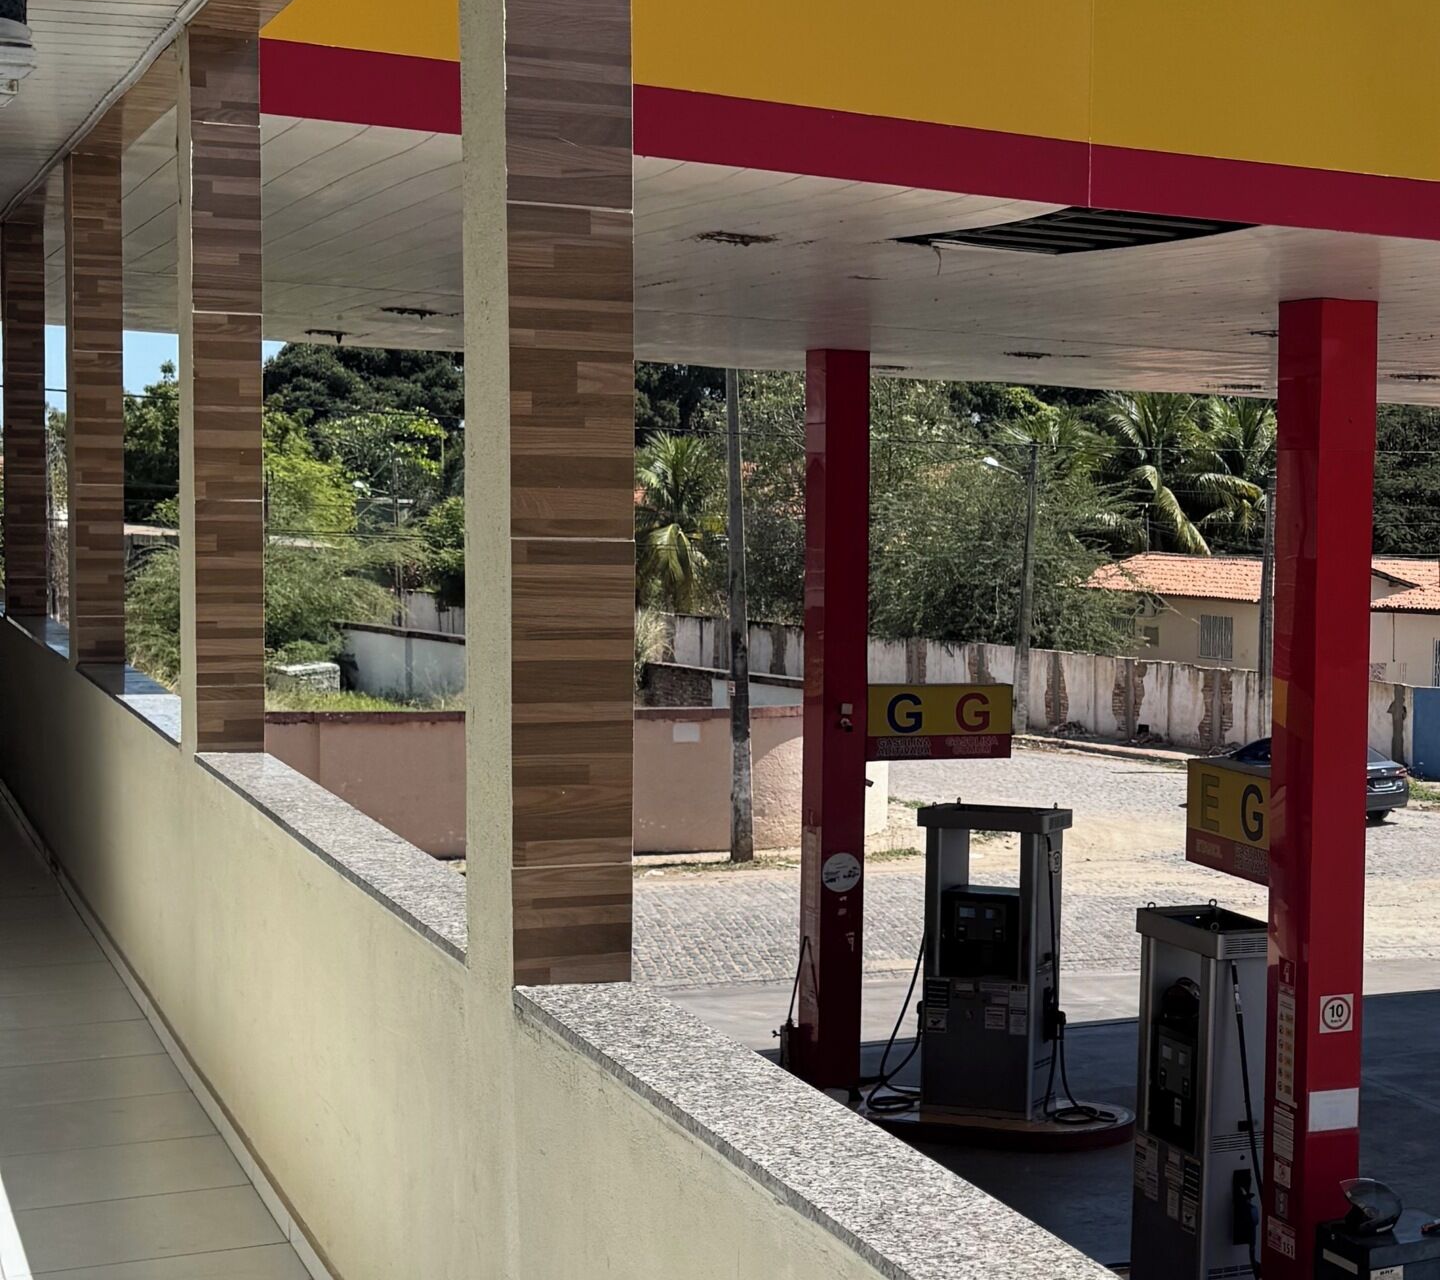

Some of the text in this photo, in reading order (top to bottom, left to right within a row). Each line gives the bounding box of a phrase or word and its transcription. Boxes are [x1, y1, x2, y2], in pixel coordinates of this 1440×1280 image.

[887, 692, 991, 734] G G
[1201, 773, 1264, 842] E G
[1328, 1004, 1344, 1019] 10
[1283, 1241, 1294, 1257] 151
